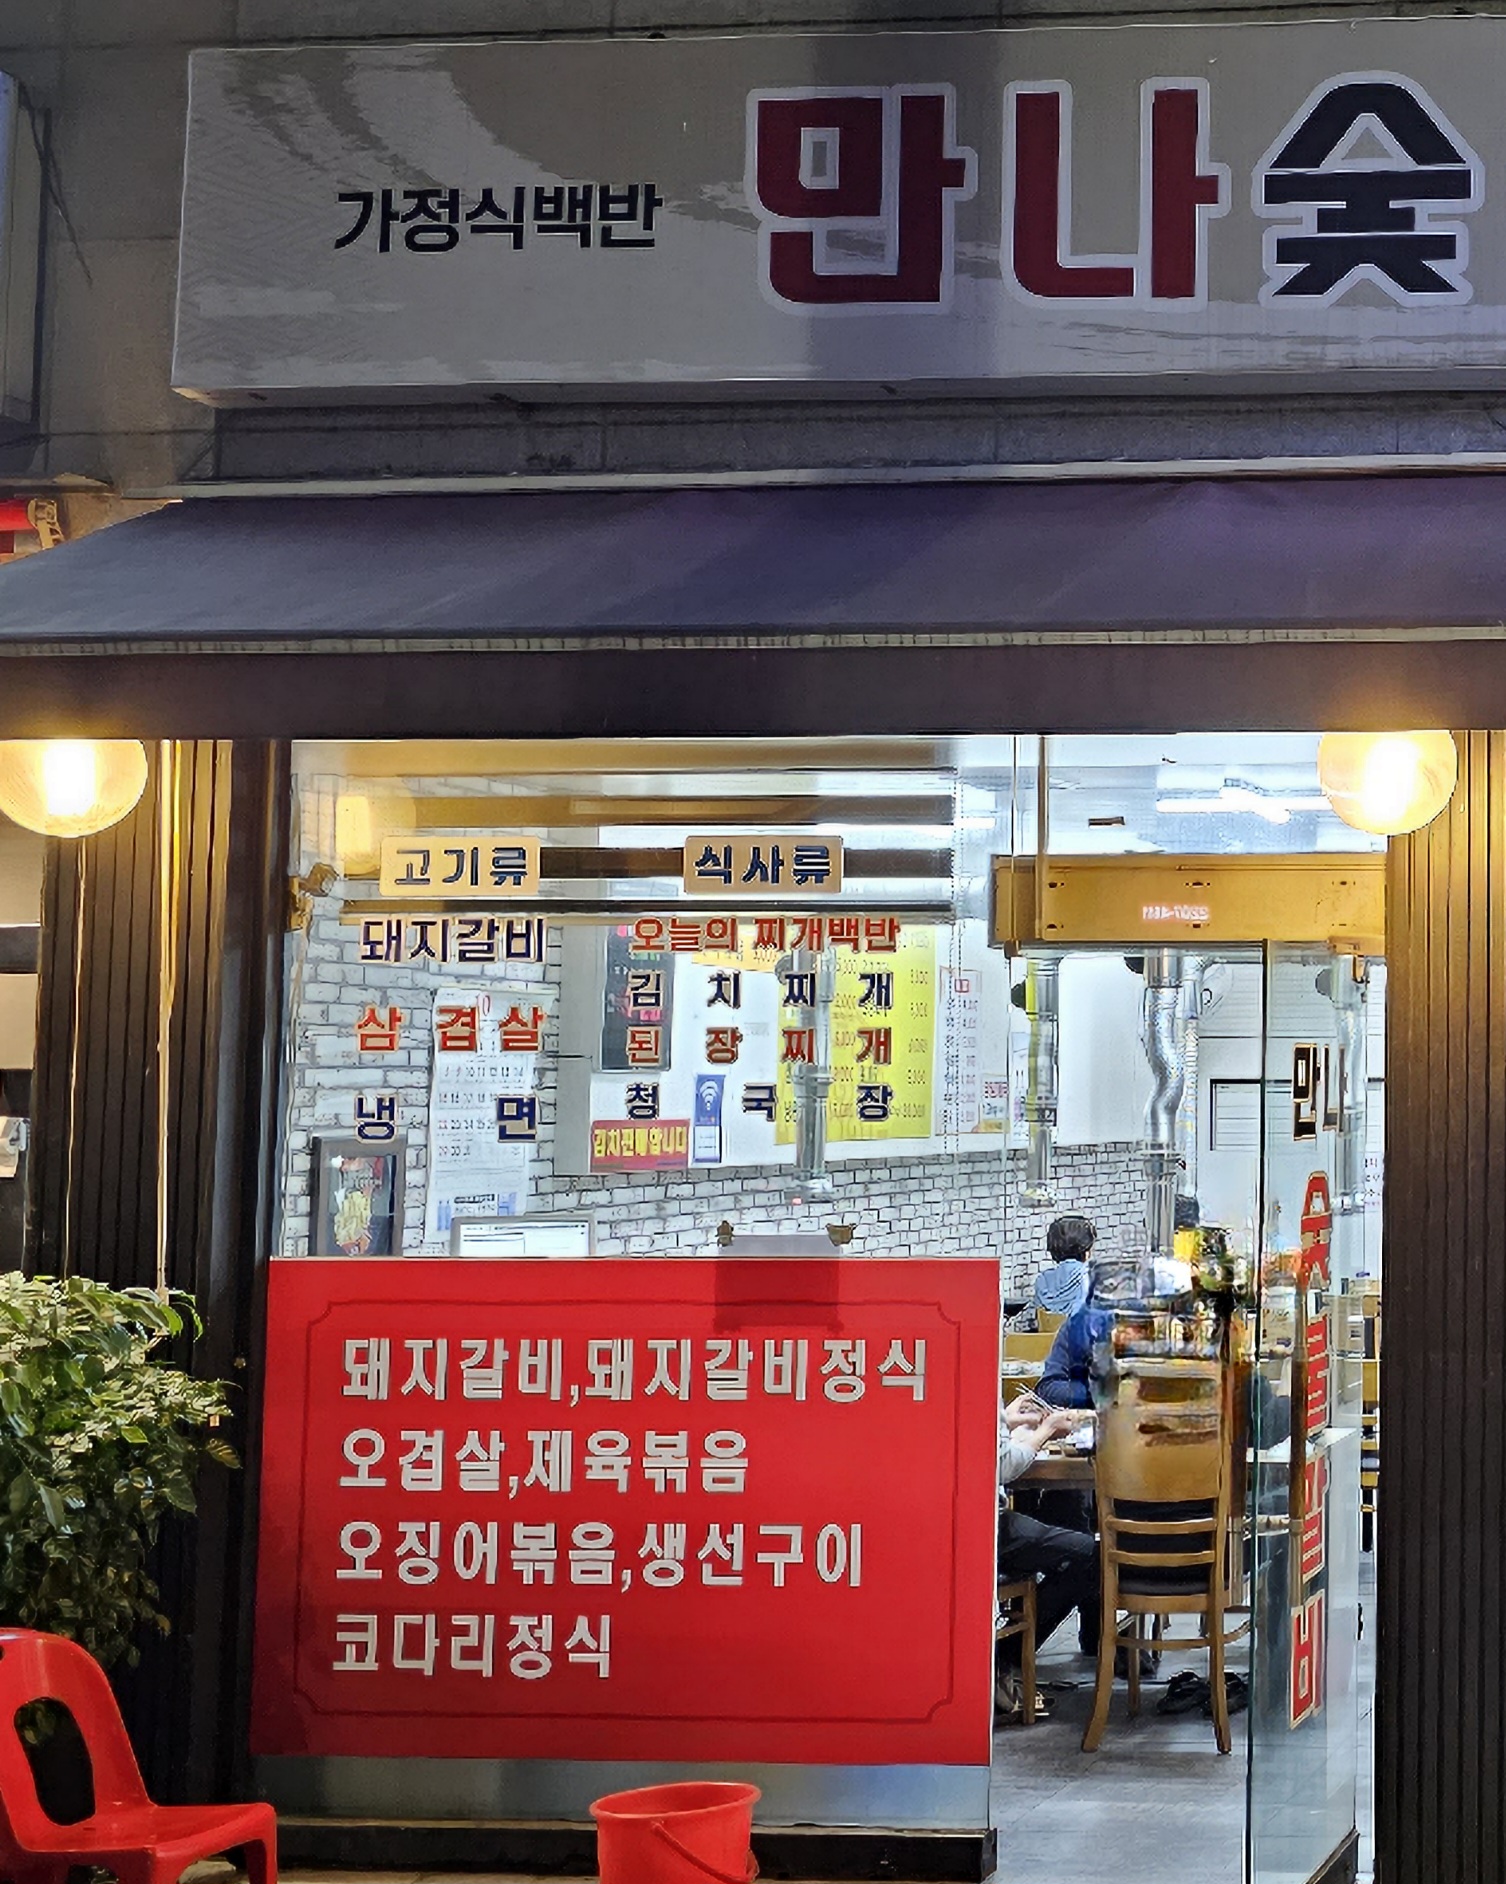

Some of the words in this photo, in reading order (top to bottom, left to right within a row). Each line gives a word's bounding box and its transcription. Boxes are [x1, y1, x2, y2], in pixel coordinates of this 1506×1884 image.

[334, 181, 662, 254] 가정식백반
[395, 846, 530, 887] 고기류
[695, 843, 831, 886] 식사류
[359, 918, 546, 965] 돼지갈비
[631, 916, 740, 953] 오늘의
[754, 916, 900, 953] 찌개백반
[356, 1005, 547, 1054] 삼겹살
[1291, 1043, 1349, 1141] 만나
[342, 1337, 928, 1408] 돼지갈비,돼지갈비정식
[338, 1428, 750, 1498] 오겹살,제육볶음
[335, 1520, 864, 1593] 오징어볶음,생선구이
[332, 1613, 613, 1679] 코다리정식
